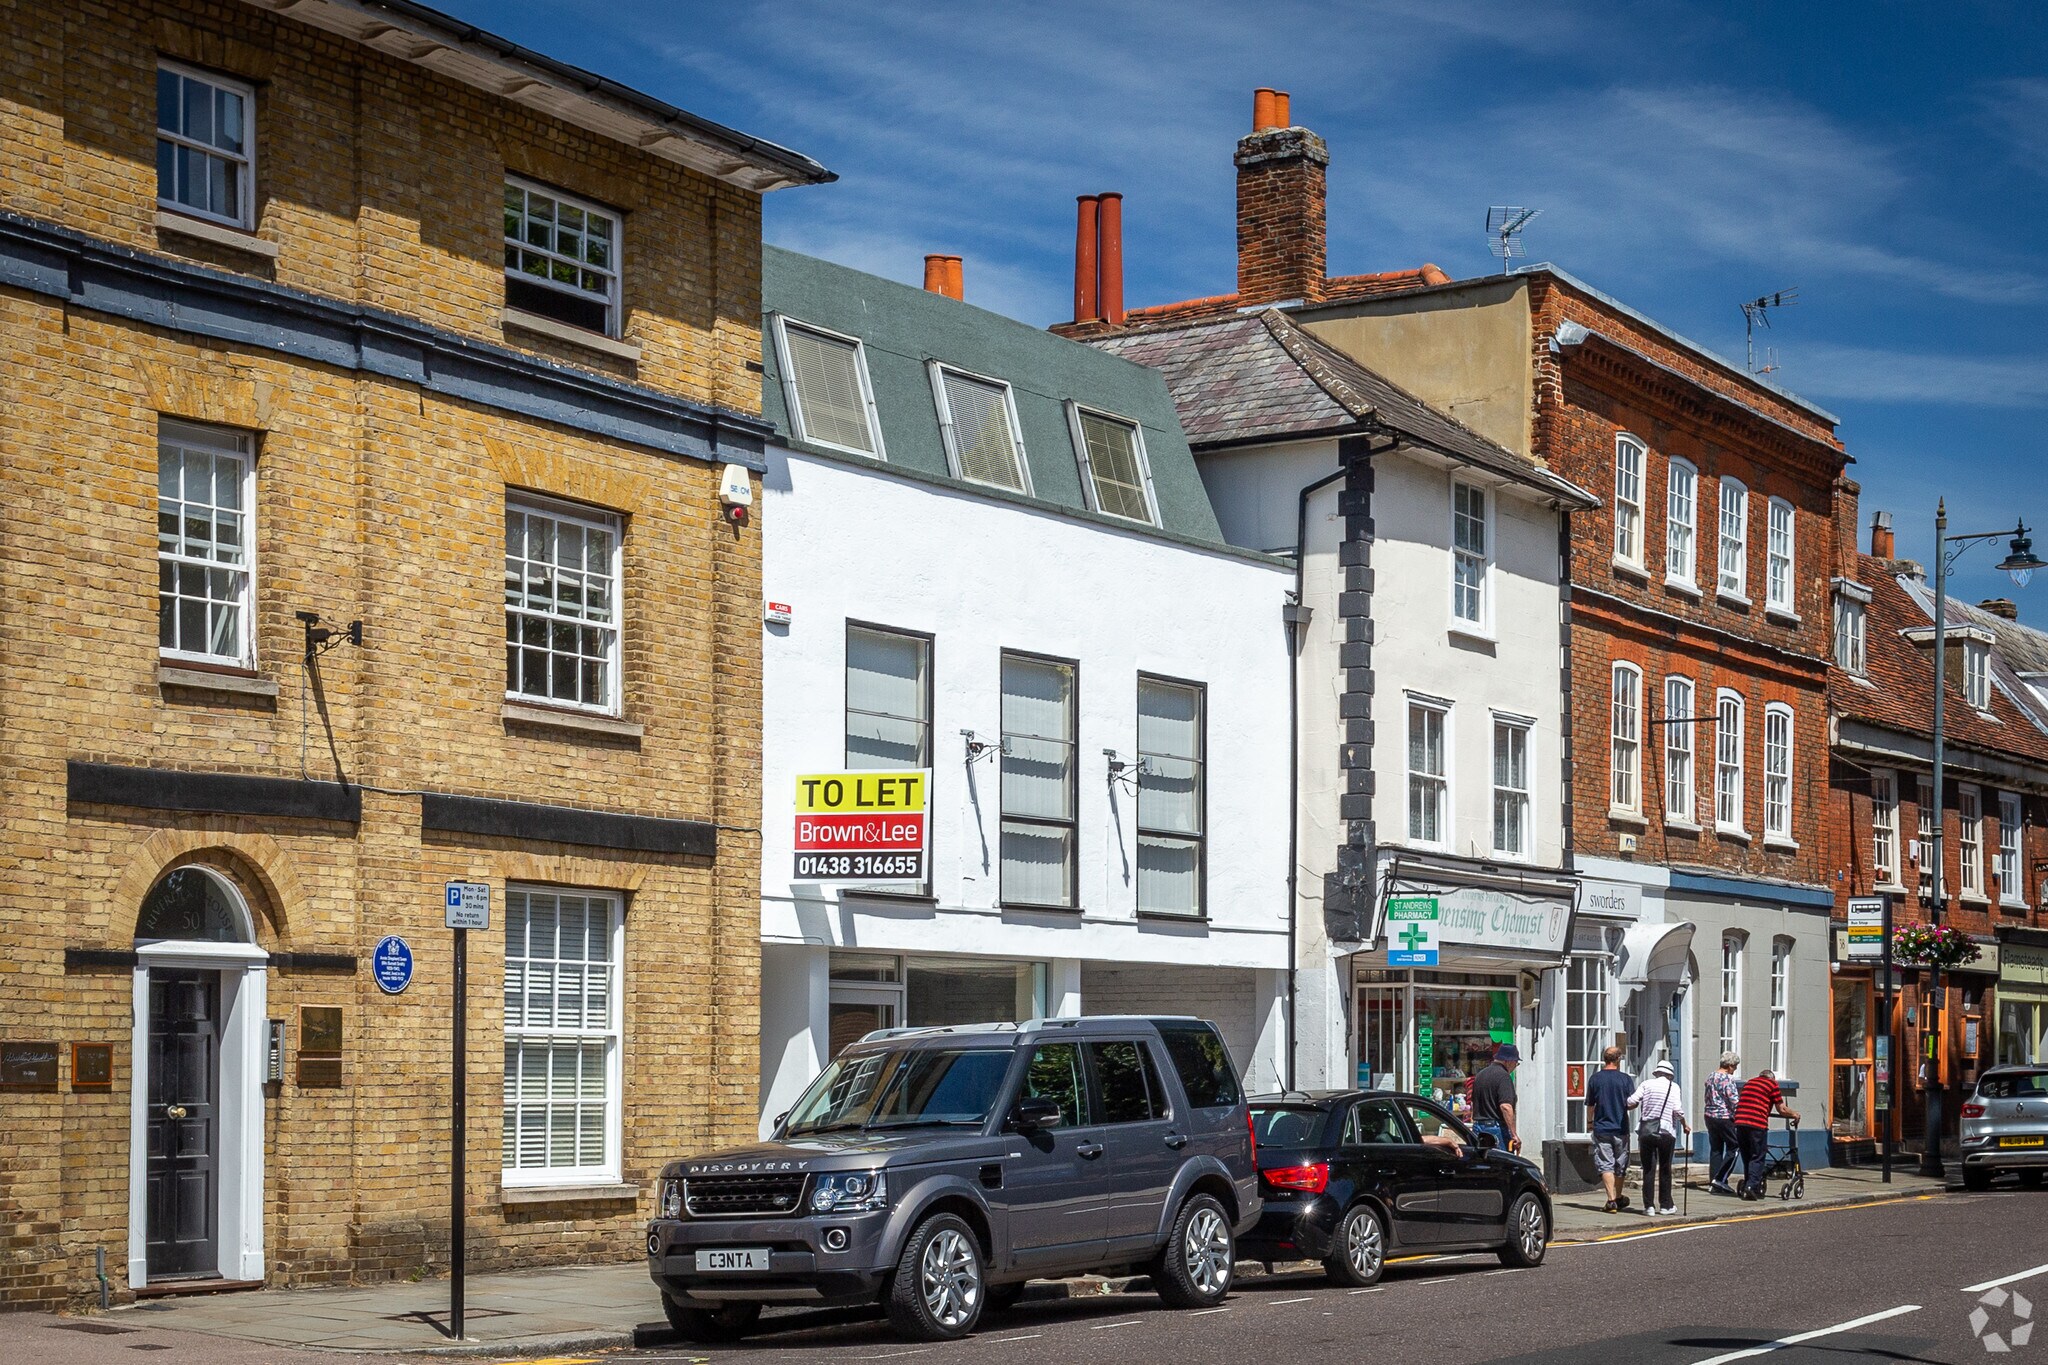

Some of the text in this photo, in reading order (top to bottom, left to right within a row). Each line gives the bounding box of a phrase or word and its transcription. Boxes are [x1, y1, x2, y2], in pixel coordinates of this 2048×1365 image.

[802, 778, 919, 807] TO LET
[799, 856, 917, 875] 01438 316655
[450, 889, 459, 904] P
[1402, 901, 1433, 910] ANDREWS
[1590, 889, 1625, 911] sworders
[183, 911, 200, 930] 50
[1394, 911, 1433, 919] PHARMACY
[1491, 904, 1544, 936] Chemist
[2003, 950, 2044, 971] Flamsteads
[690, 1161, 808, 1173] DISCOVERY
[709, 1252, 753, 1268] C3NTA
